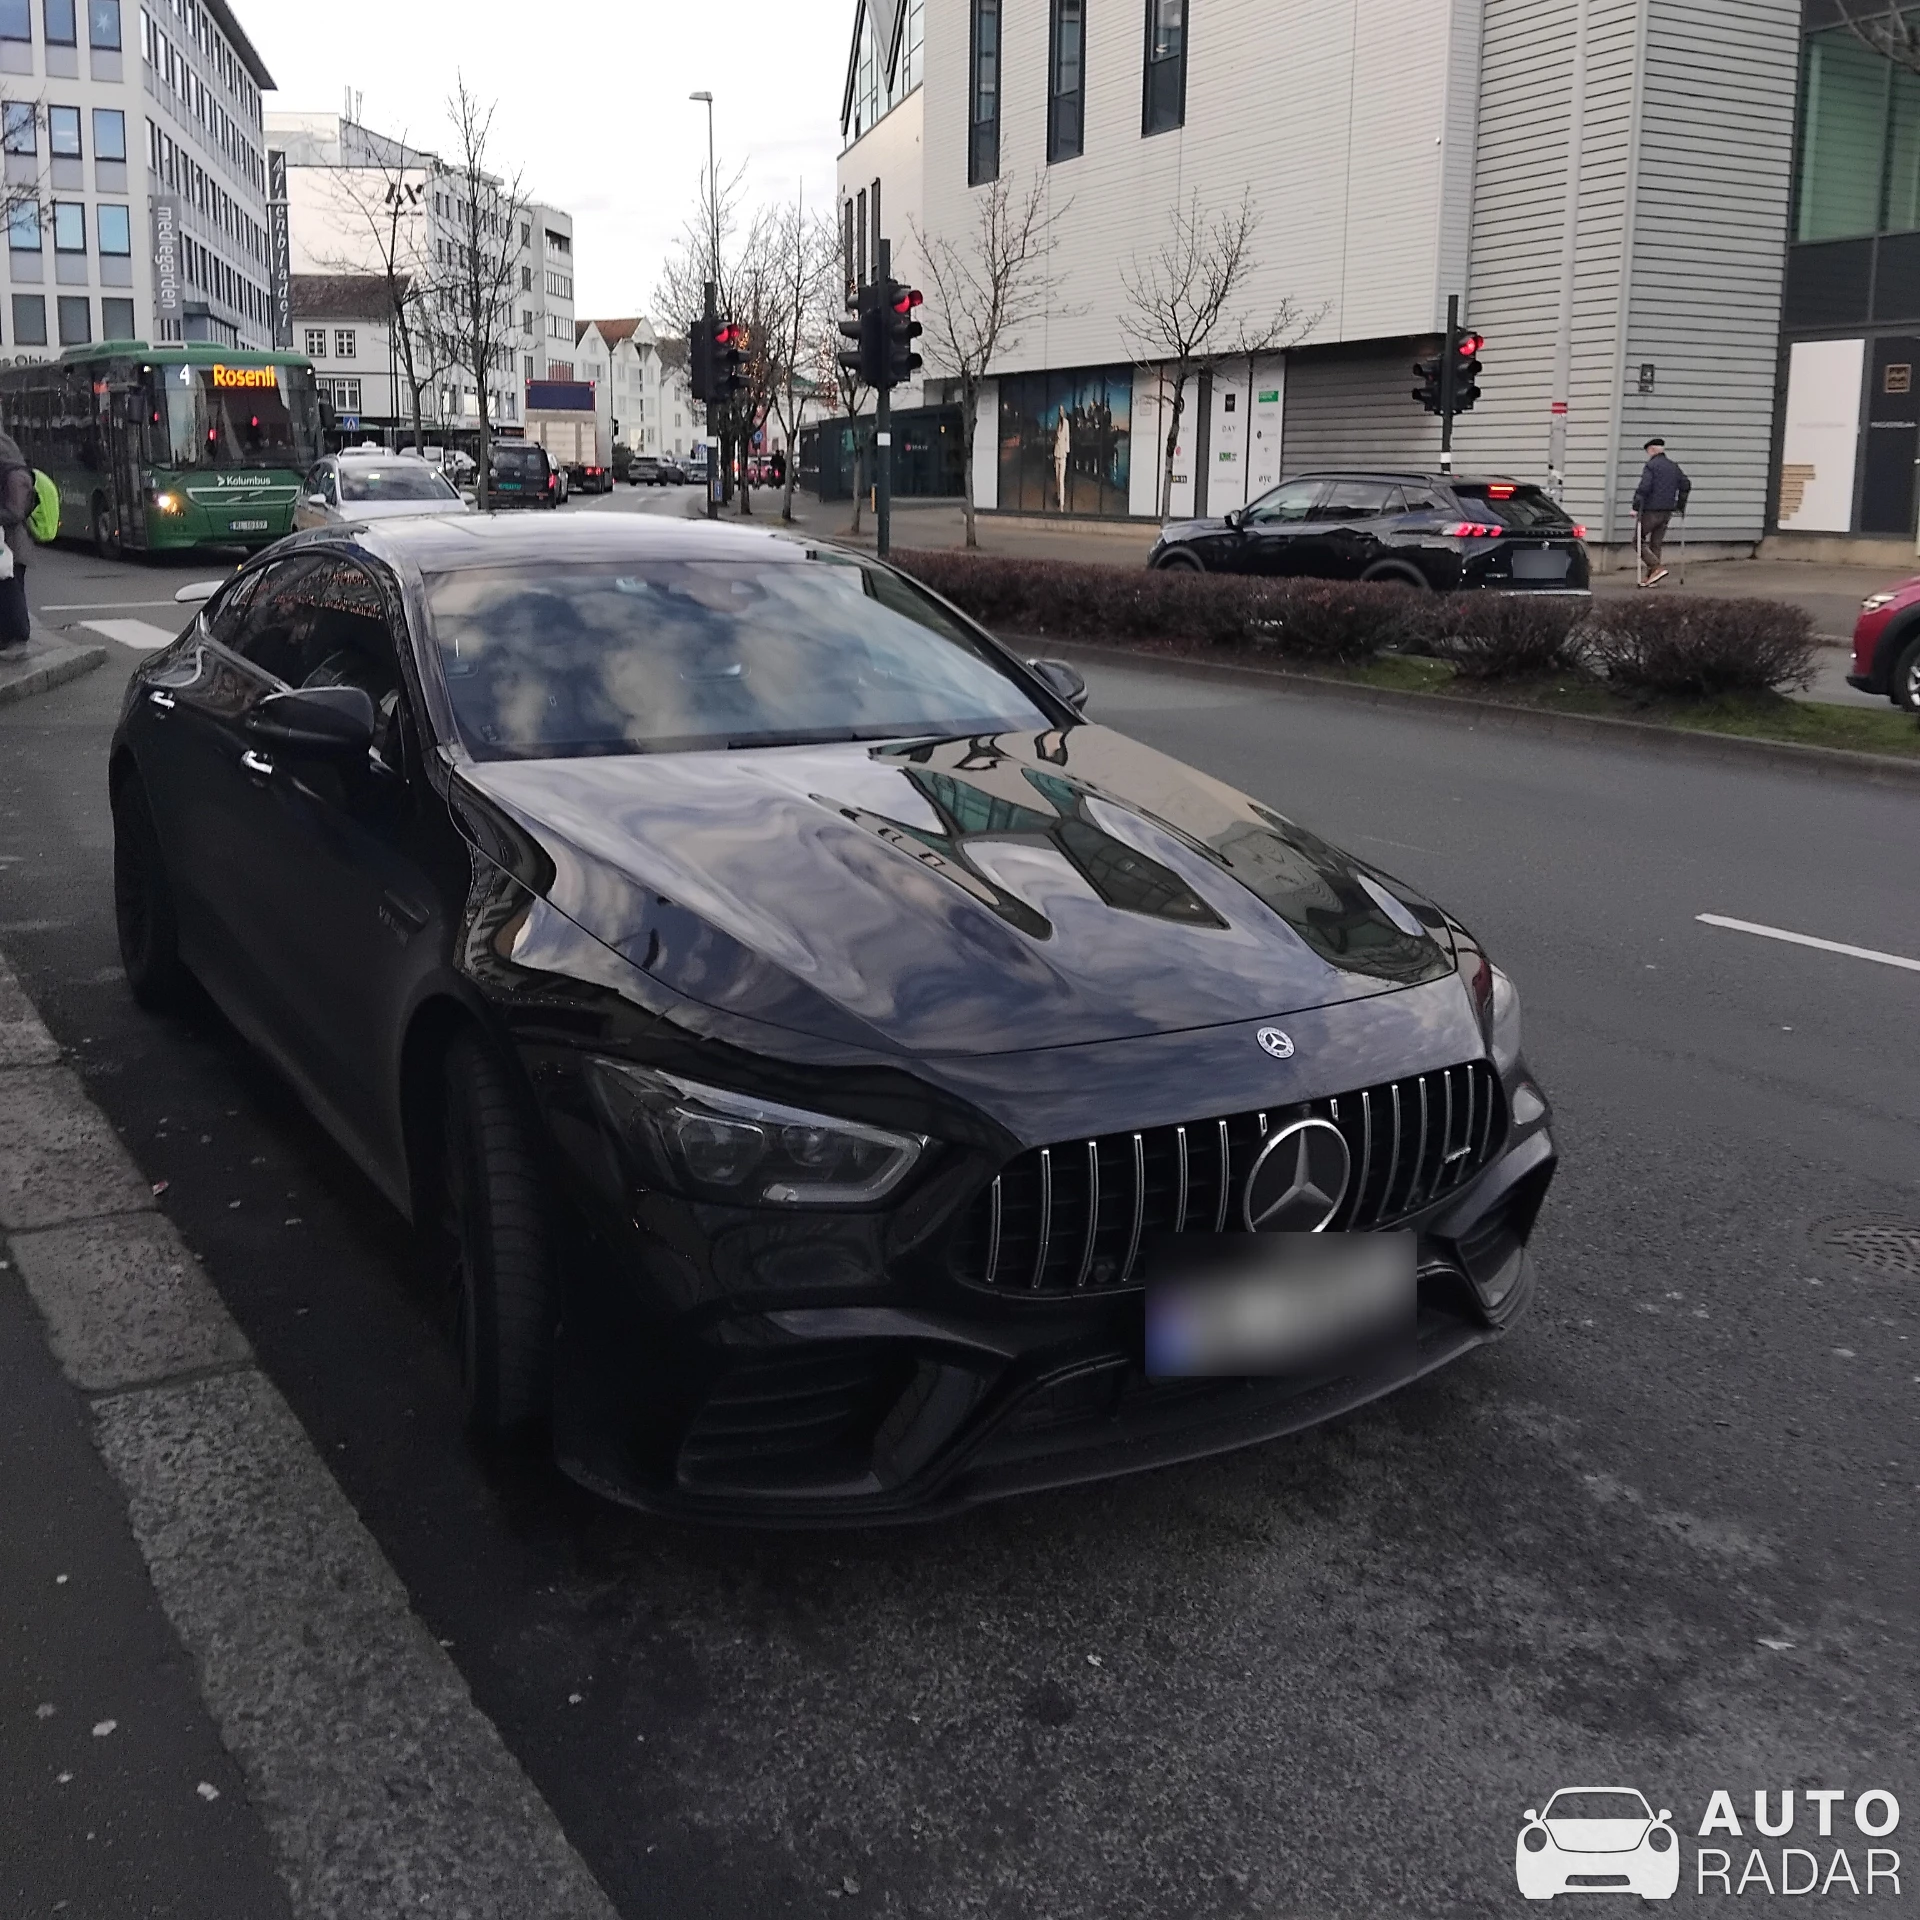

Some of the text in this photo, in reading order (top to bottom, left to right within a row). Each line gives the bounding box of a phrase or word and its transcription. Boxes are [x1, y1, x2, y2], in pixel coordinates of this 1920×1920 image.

[155, 206, 180, 309] mediegarden
[179, 363, 275, 387] 4 Rosenli
[227, 475, 271, 486] Kolumbus
